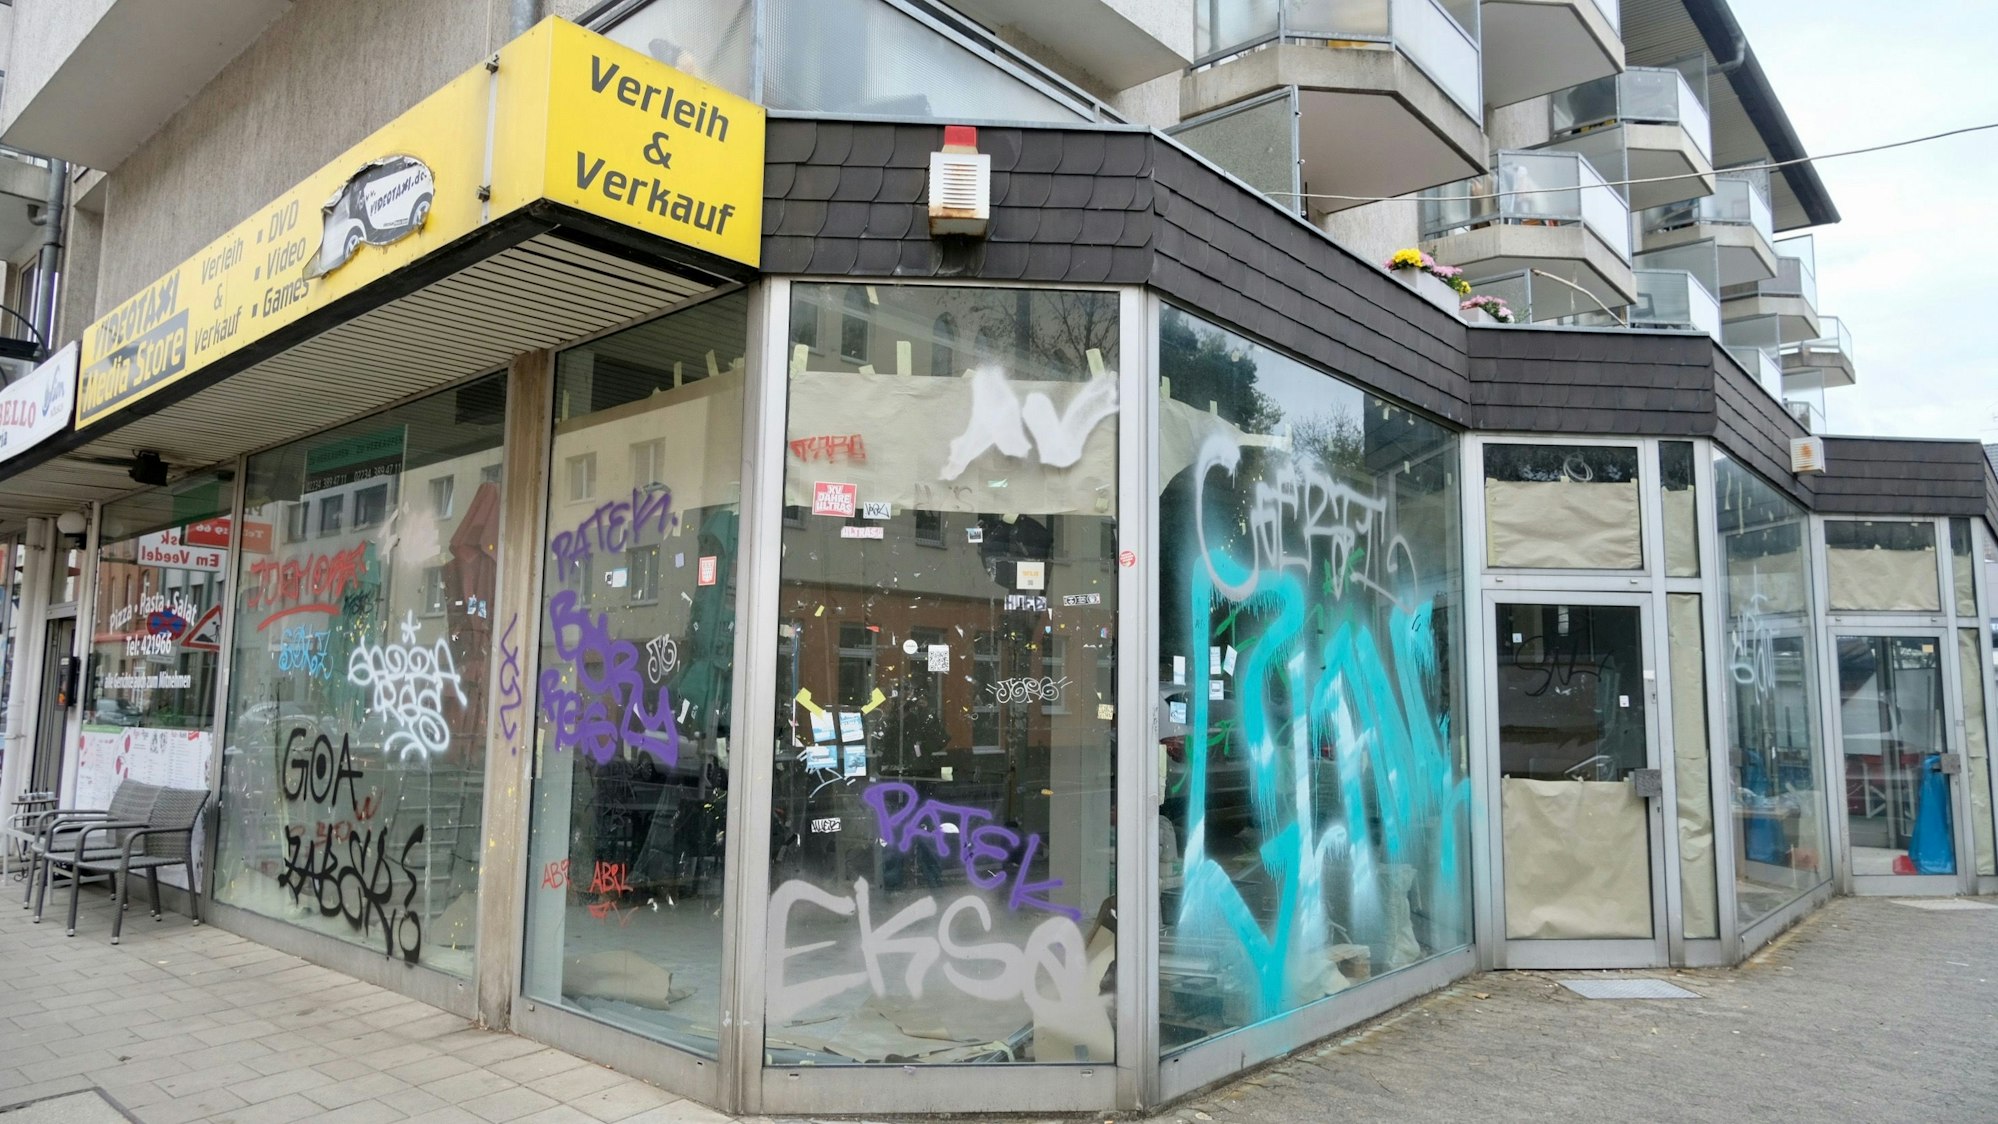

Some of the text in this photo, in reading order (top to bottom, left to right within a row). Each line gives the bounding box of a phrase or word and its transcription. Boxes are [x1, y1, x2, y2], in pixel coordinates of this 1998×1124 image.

[591, 54, 730, 143] Verleih
[642, 131, 672, 170] &
[576, 150, 736, 236] Verkauf
[267, 199, 299, 244] DVD
[201, 236, 244, 285] Verleih
[266, 237, 307, 281] Video
[94, 269, 181, 361] VIDEOTAXI
[213, 282, 224, 311] &
[262, 279, 309, 319] Games
[193, 305, 243, 355] Verkauf
[81, 326, 185, 413] Media Store
[353, 468, 372, 482] 02234
[815, 501, 853, 515] ULTRAS
[110, 591, 198, 635] Pizza Pasta Salat
[126, 633, 172, 657] Tel: 421966
[159, 670, 191, 689] Mitnehmen
[283, 727, 364, 812] GOA
